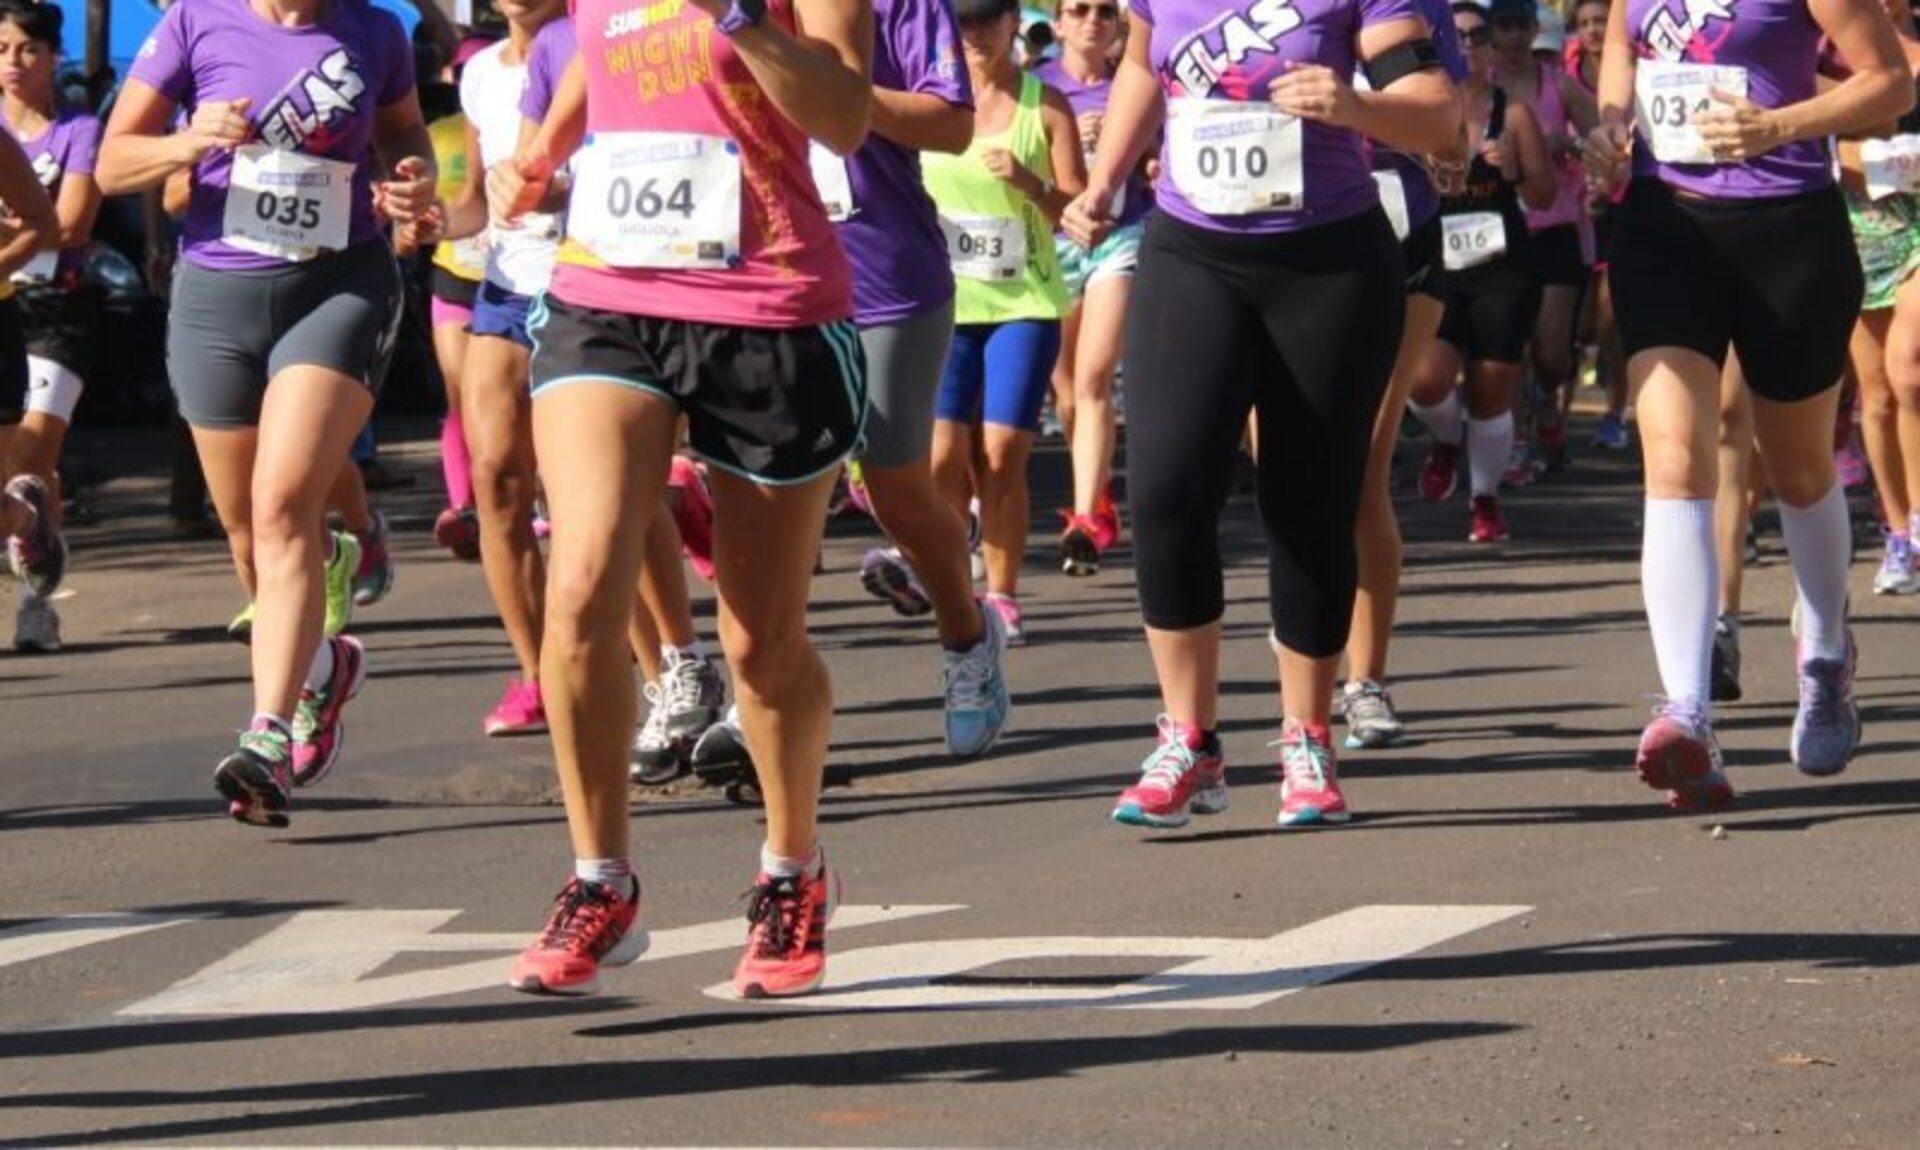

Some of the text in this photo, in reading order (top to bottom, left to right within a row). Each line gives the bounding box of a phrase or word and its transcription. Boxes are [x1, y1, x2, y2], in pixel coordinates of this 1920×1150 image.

[605, 18, 714, 77] NIGHT
[1173, 0, 1304, 98] ELAS
[1645, 0, 1736, 62] ELA
[260, 48, 366, 150] ELAS
[638, 61, 714, 103] RUN
[1197, 145, 1268, 179] 010
[255, 190, 322, 230] 035
[606, 176, 696, 220] 064
[958, 231, 1003, 258] 083
[1448, 229, 1488, 251] 016
